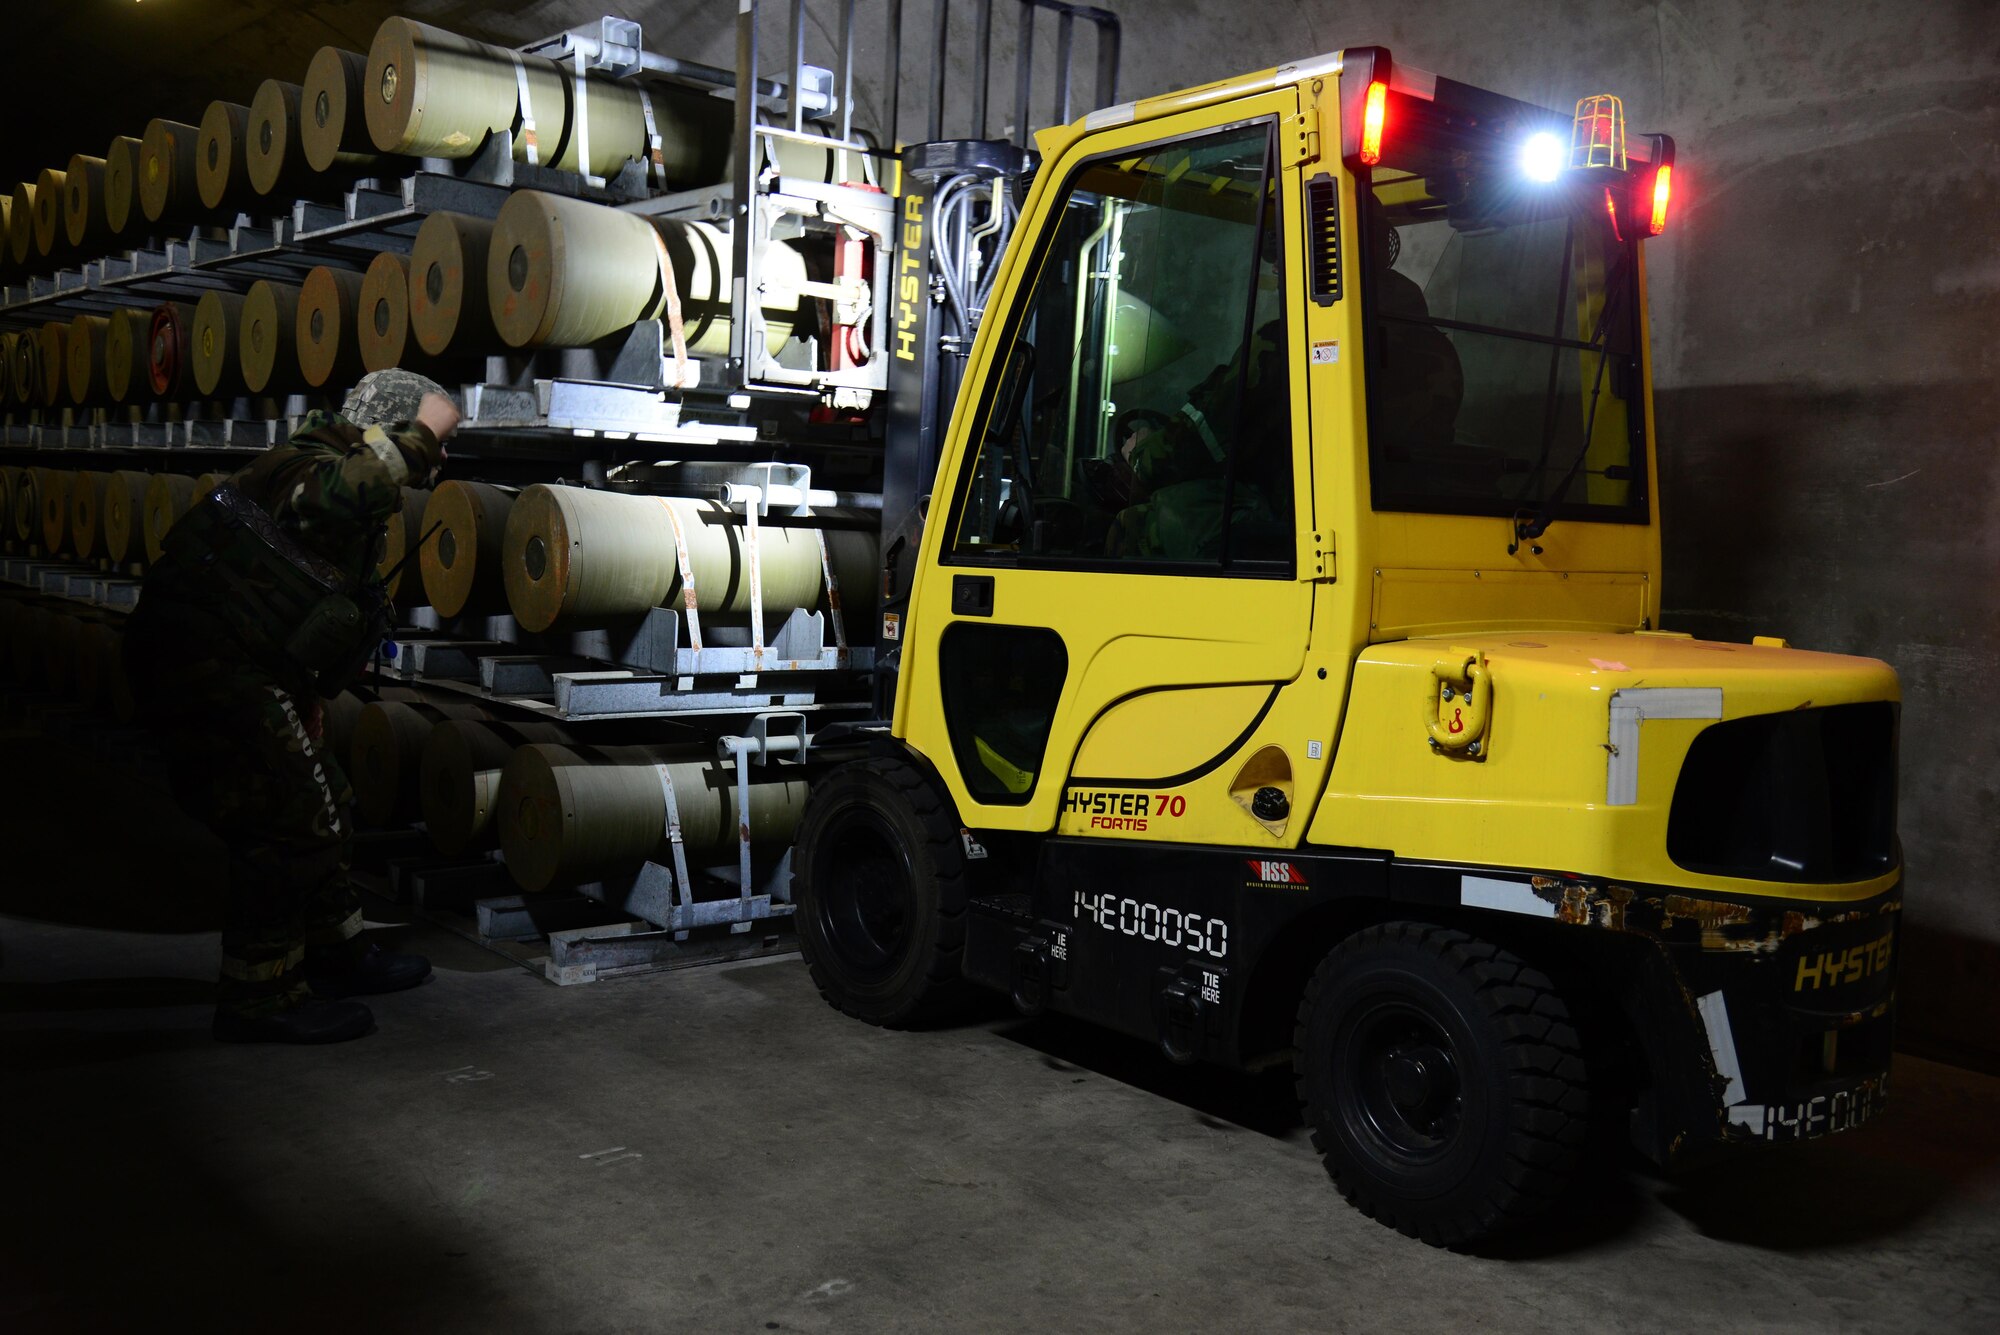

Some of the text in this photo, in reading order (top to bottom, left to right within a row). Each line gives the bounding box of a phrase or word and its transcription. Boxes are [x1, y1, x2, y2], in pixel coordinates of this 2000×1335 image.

[896, 194, 924, 361] HYSTER
[1062, 791, 1186, 818] HYSTER 70
[1091, 816, 1148, 831] FORTIS
[1261, 861, 1290, 882] HSS
[1074, 890, 1228, 957] 14E00050
[1050, 944, 1067, 960] HERE
[1202, 970, 1220, 989] TIE
[1201, 985, 1221, 1004] HERE
